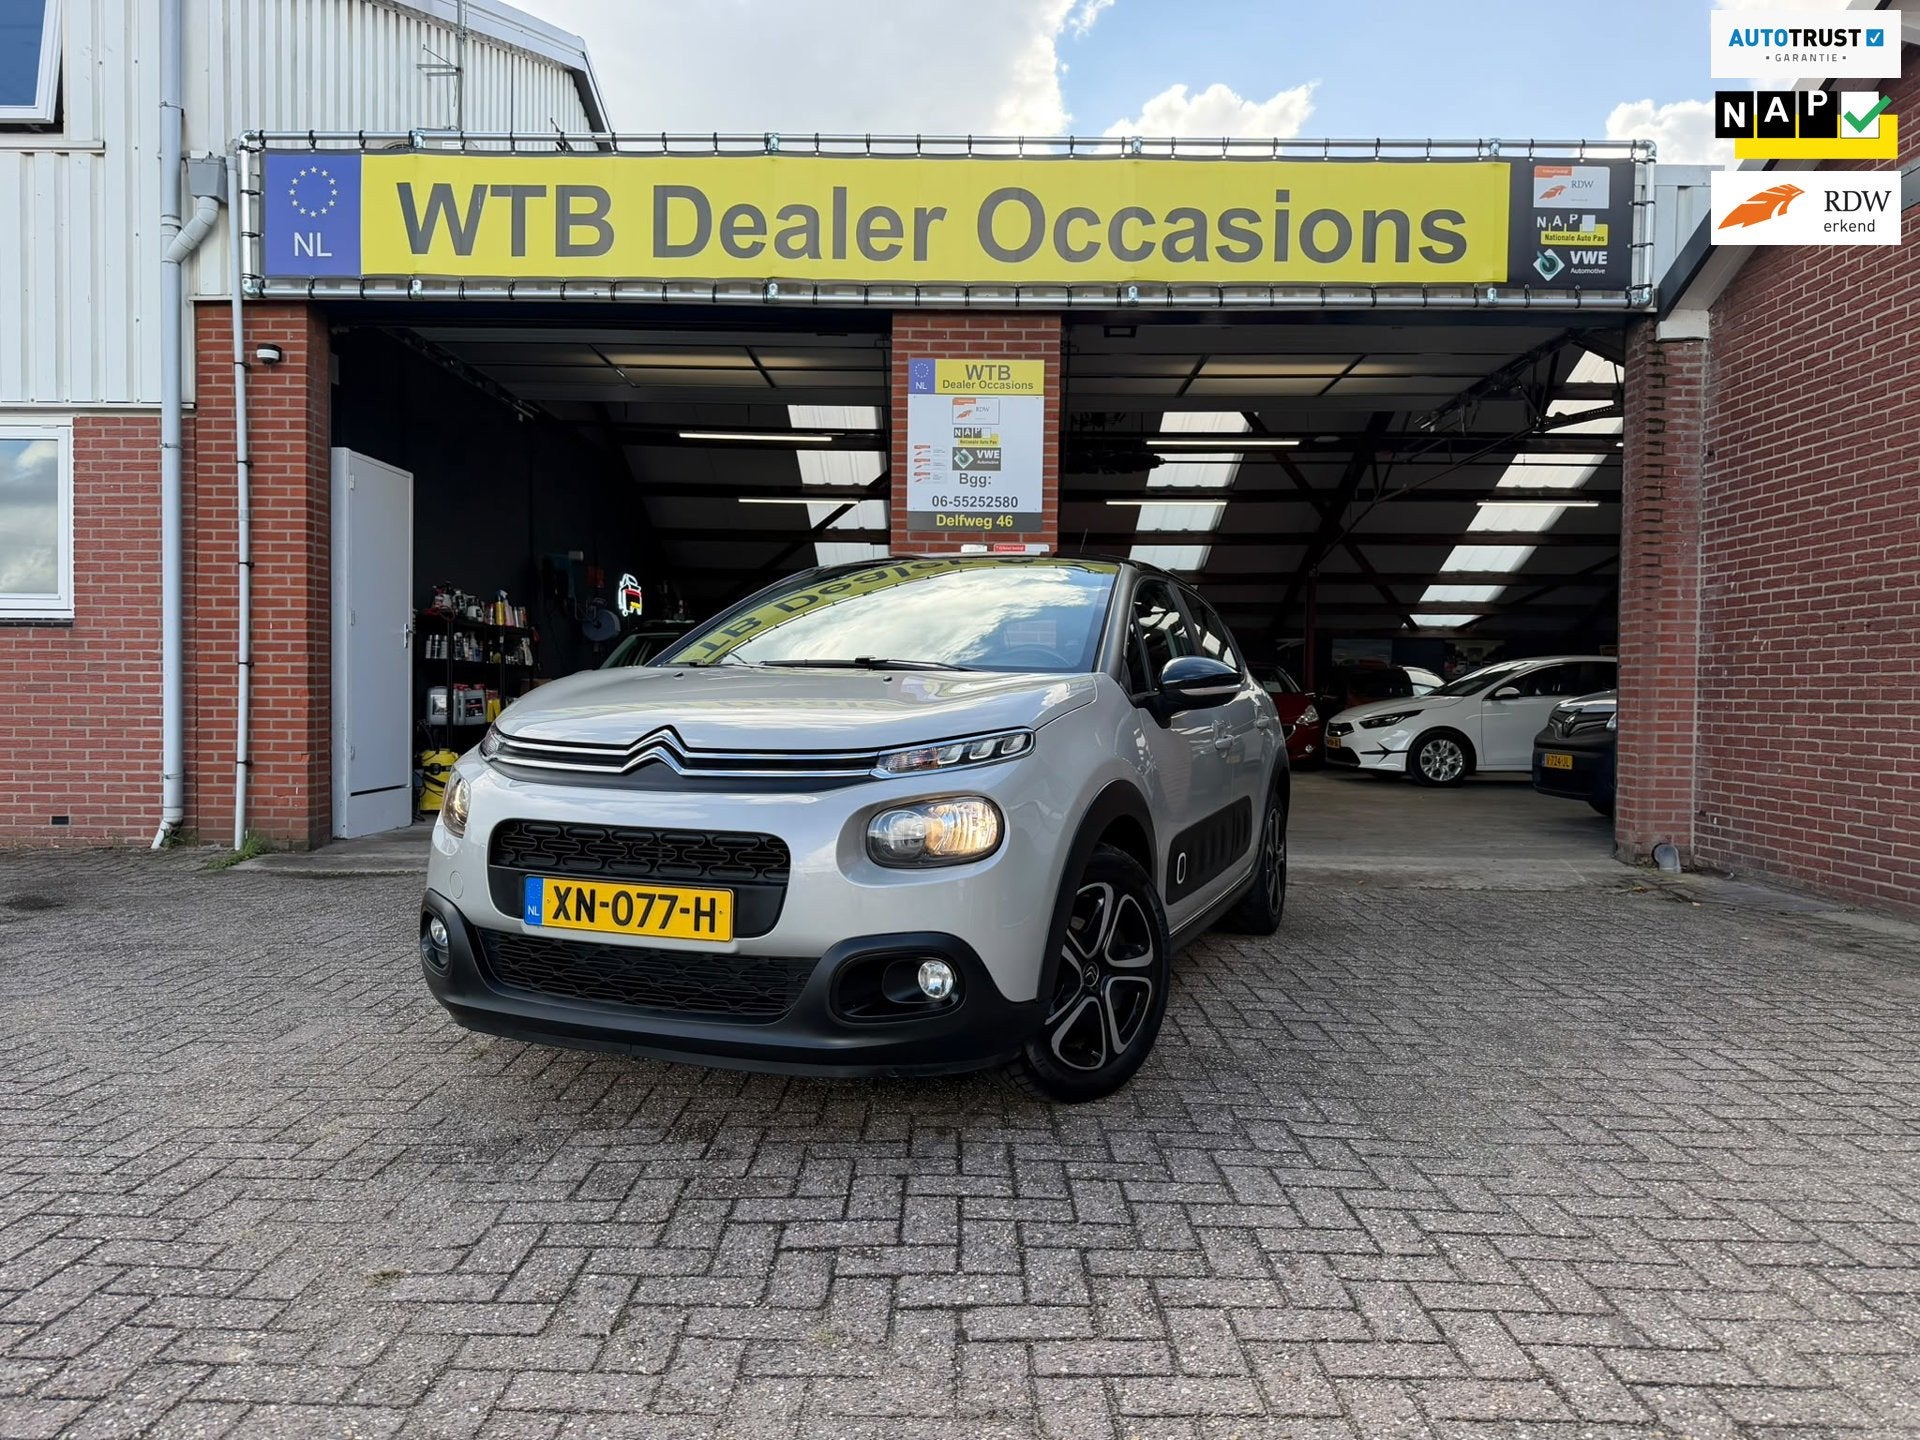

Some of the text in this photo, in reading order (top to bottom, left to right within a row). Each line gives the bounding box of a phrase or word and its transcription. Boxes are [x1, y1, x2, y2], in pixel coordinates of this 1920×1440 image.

[1571, 180, 1594, 189] RDW
[395, 181, 1468, 265] WTB Dealer Occasions
[293, 231, 332, 257] NL
[1544, 233, 1575, 242] Nationale
[1576, 234, 1591, 242] Auto
[1570, 250, 1608, 265] VWE
[965, 364, 1011, 381] WTB
[915, 382, 927, 390] NL
[942, 380, 1034, 390] Dealer Occasions
[976, 450, 1000, 459] VWE
[959, 473, 992, 488] Bgg:
[931, 496, 1019, 508] 06-55252580
[936, 514, 1014, 528] Delfweg 46
[527, 905, 541, 917] NL
[552, 885, 716, 933] XN-077-H
